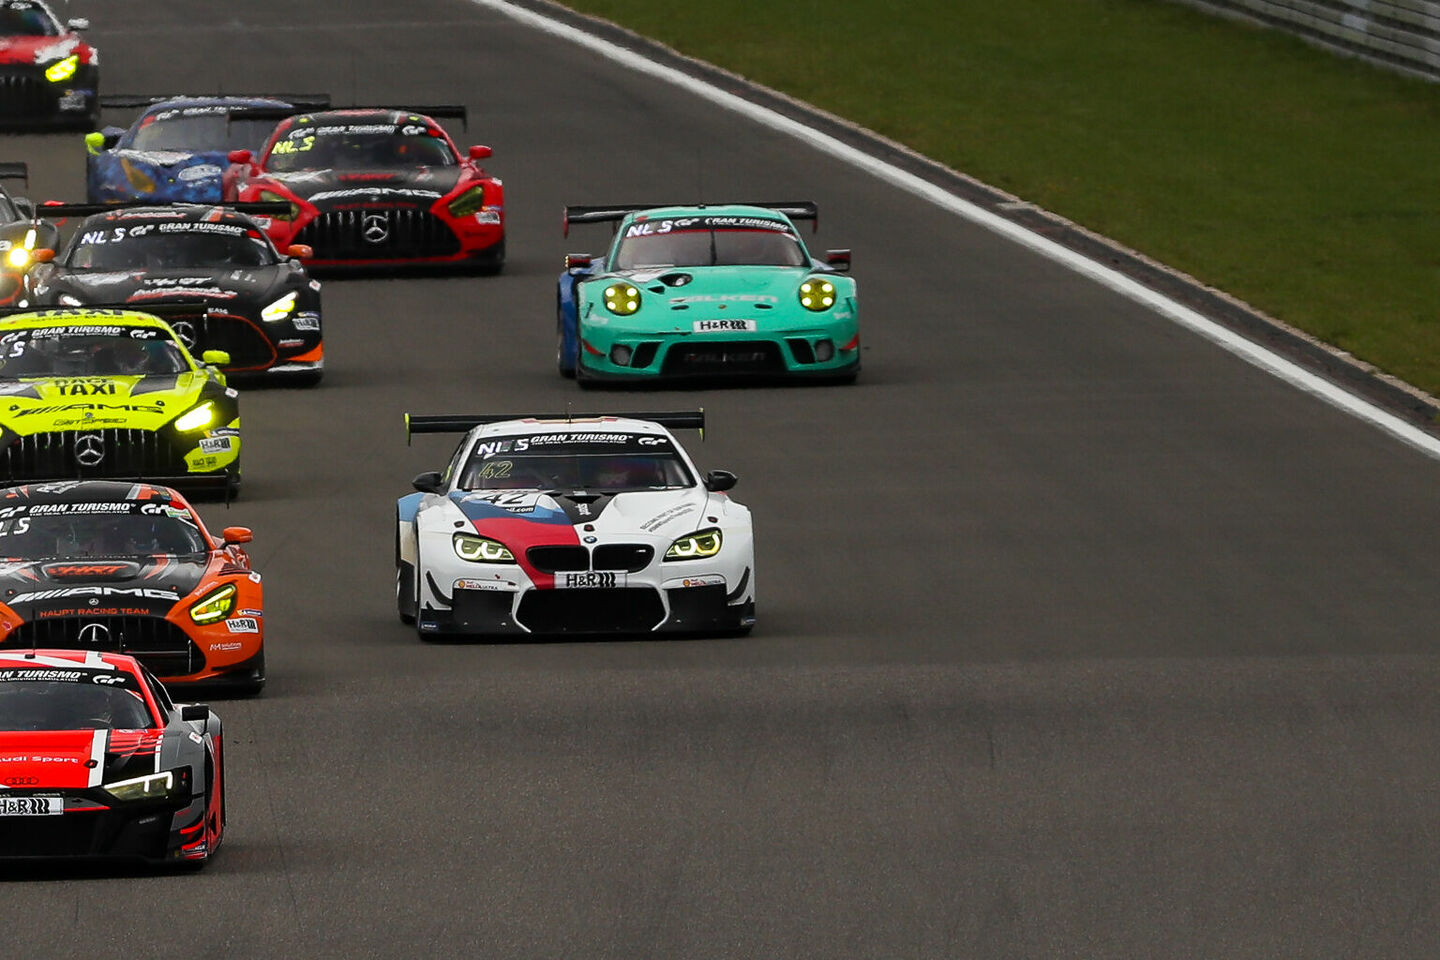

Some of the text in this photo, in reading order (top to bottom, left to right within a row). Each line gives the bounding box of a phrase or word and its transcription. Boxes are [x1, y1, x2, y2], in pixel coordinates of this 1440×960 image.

[159, 222, 246, 235] GRAN TURISMO
[32, 326, 122, 337] GRAN TURISMO
[58, 383, 117, 396] TAXI
[531, 434, 567, 443] GRAN
[571, 433, 629, 442] TURISMO
[29, 503, 131, 514] GRAN TURISMO
[566, 573, 596, 587] H&R
[40, 607, 150, 618] HAUPT RACING TEAM
[17, 670, 83, 679] TURISMO
[31, 755, 79, 764] Sport
